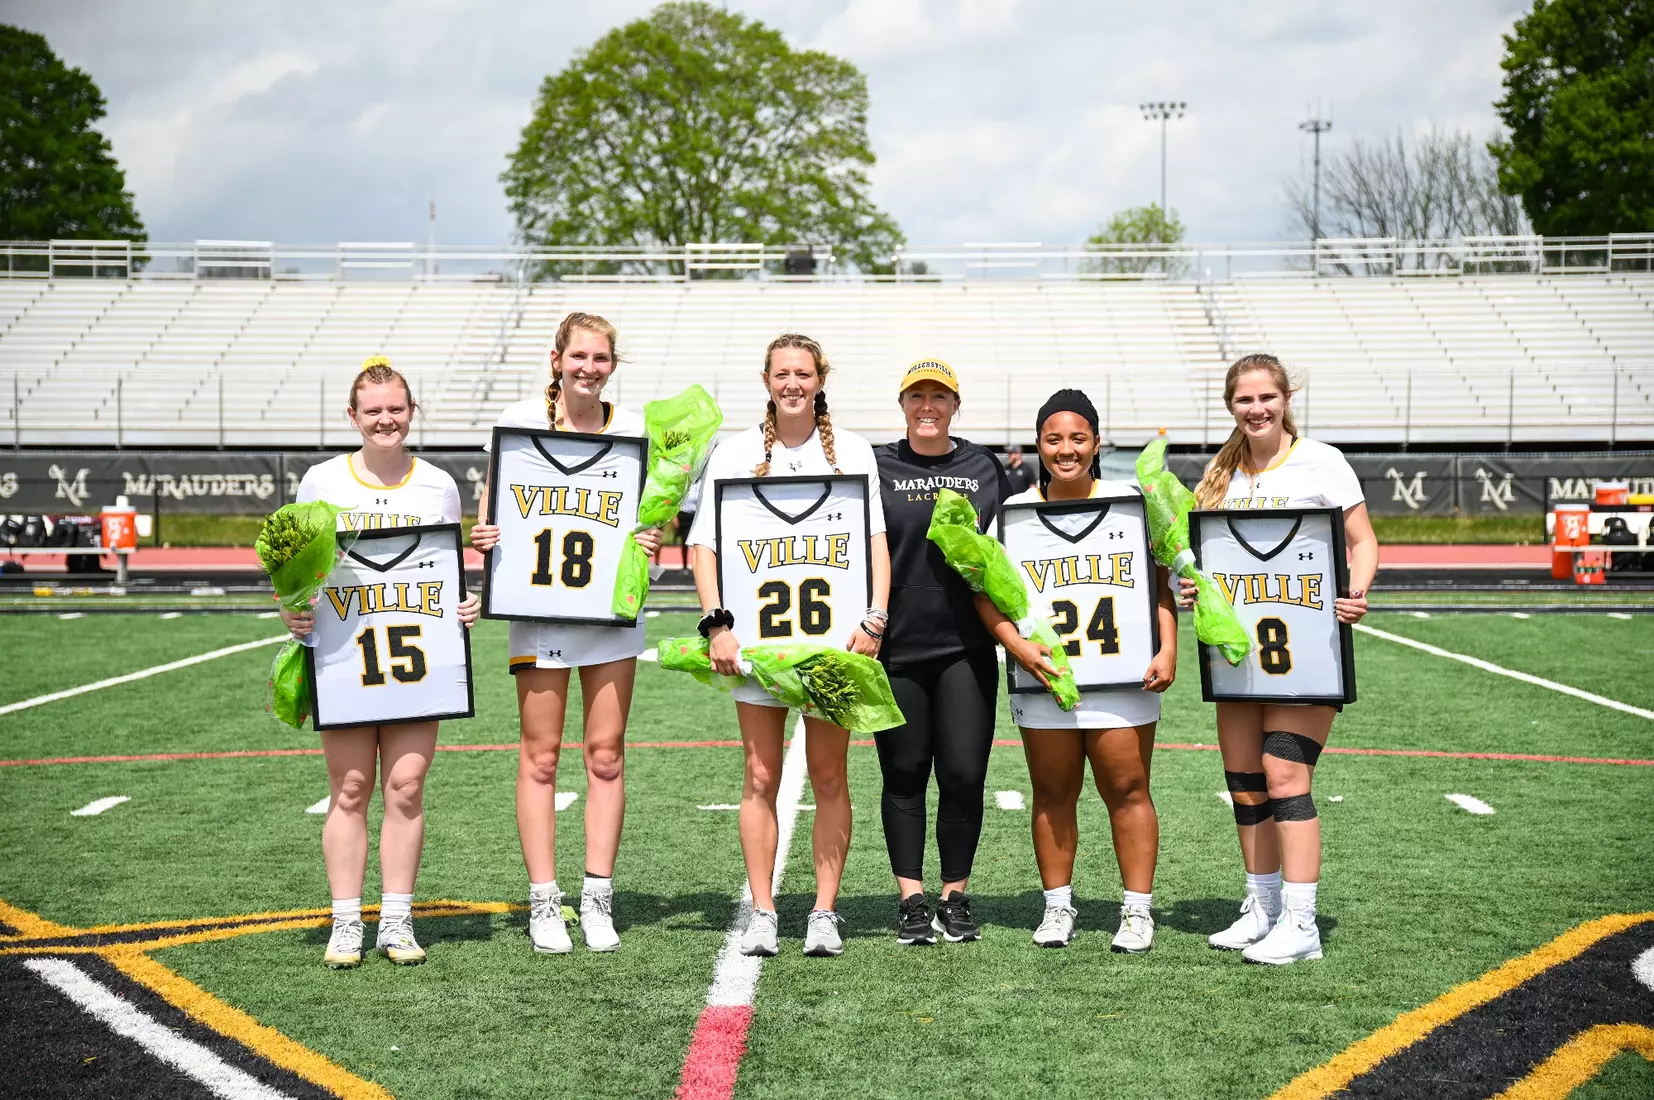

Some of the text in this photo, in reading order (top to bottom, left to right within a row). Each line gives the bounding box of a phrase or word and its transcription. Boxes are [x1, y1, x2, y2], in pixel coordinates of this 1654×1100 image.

[907, 361, 952, 378] MILLERSVILLE
[122, 471, 275, 500] MARAUDERS
[893, 476, 979, 492] MARAUDERS
[907, 492, 969, 502] LACRE
[510, 484, 623, 528] VILLE
[530, 526, 597, 590] 18
[738, 532, 850, 573] VILLE
[1021, 551, 1134, 593] VILLE
[324, 580, 443, 621] VILLE
[757, 576, 832, 639] 26
[1213, 572, 1323, 610] VILLE
[1050, 595, 1121, 658] 24
[1255, 615, 1293, 676] 8
[356, 623, 428, 687] 15
